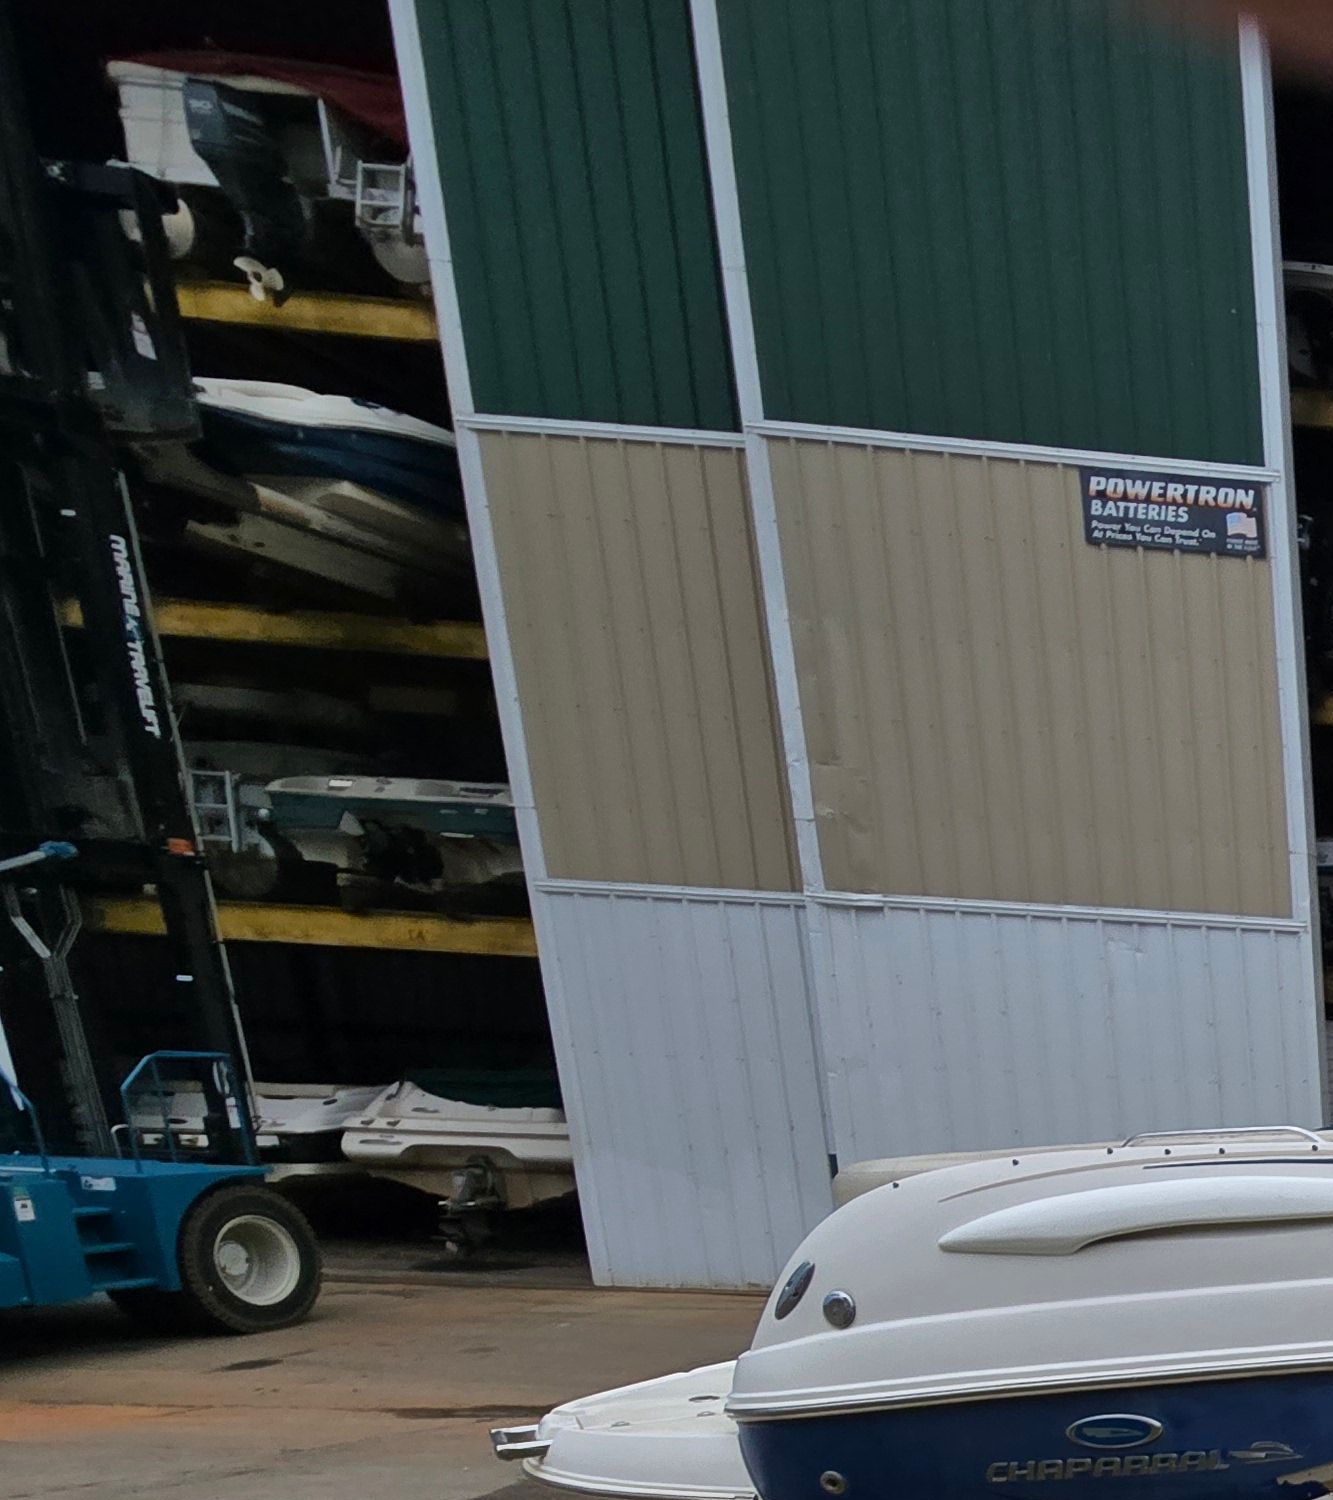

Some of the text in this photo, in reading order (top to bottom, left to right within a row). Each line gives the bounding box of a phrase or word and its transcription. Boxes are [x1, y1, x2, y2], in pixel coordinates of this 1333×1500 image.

[1088, 476, 1255, 509] POWERTRON
[1091, 500, 1189, 523] BATTERIES
[1124, 522, 1141, 532] You
[1143, 524, 1161, 534] Can
[1163, 526, 1200, 537] Depend
[1201, 529, 1216, 538] On
[1135, 533, 1152, 541] You
[1154, 534, 1172, 543] Can
[127, 641, 161, 739] TRAVELIFT
[986, 1449, 1230, 1483] CHAPARRAL
